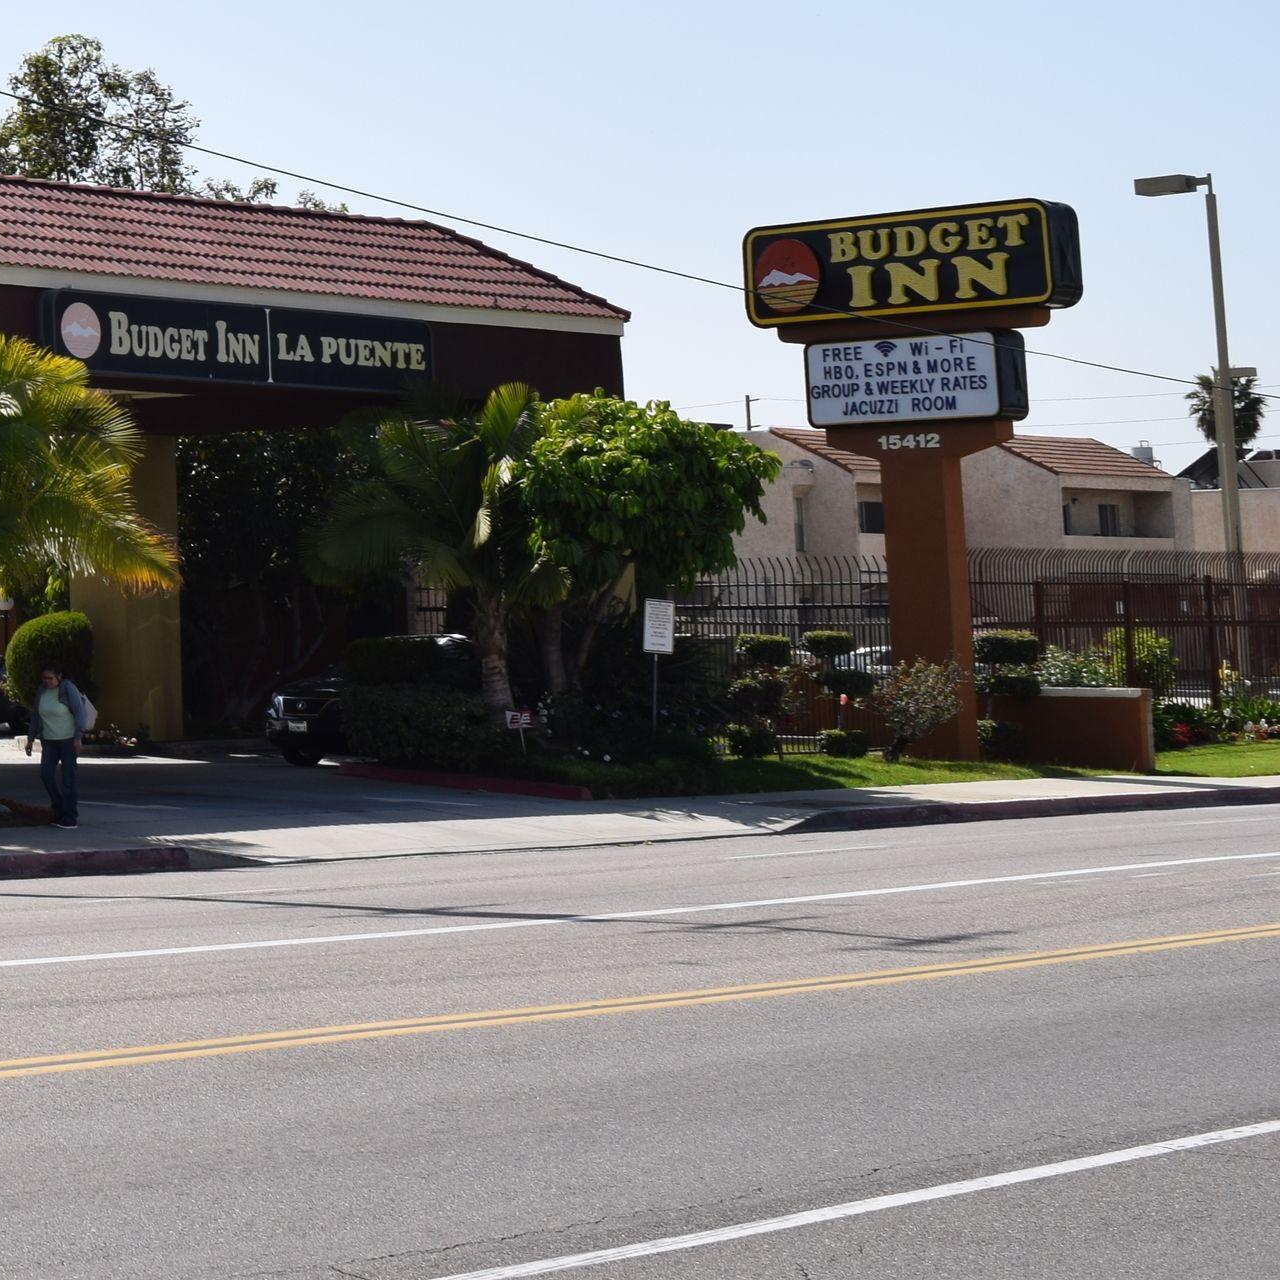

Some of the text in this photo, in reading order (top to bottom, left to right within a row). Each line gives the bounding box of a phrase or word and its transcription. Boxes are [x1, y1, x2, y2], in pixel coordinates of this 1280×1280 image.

[827, 214, 1030, 263] BUDGET
[846, 252, 1011, 308] INN
[276, 332, 426, 370] LA PUENTE
[822, 346, 863, 363] FREE
[864, 361, 908, 378] ESPN
[912, 360, 922, 375] &
[927, 356, 977, 374] MORE
[811, 375, 988, 400] GROUP & WEEKLY RATES
[842, 396, 957, 416] JACUZZI ROOM
[877, 433, 940, 450] 15412
